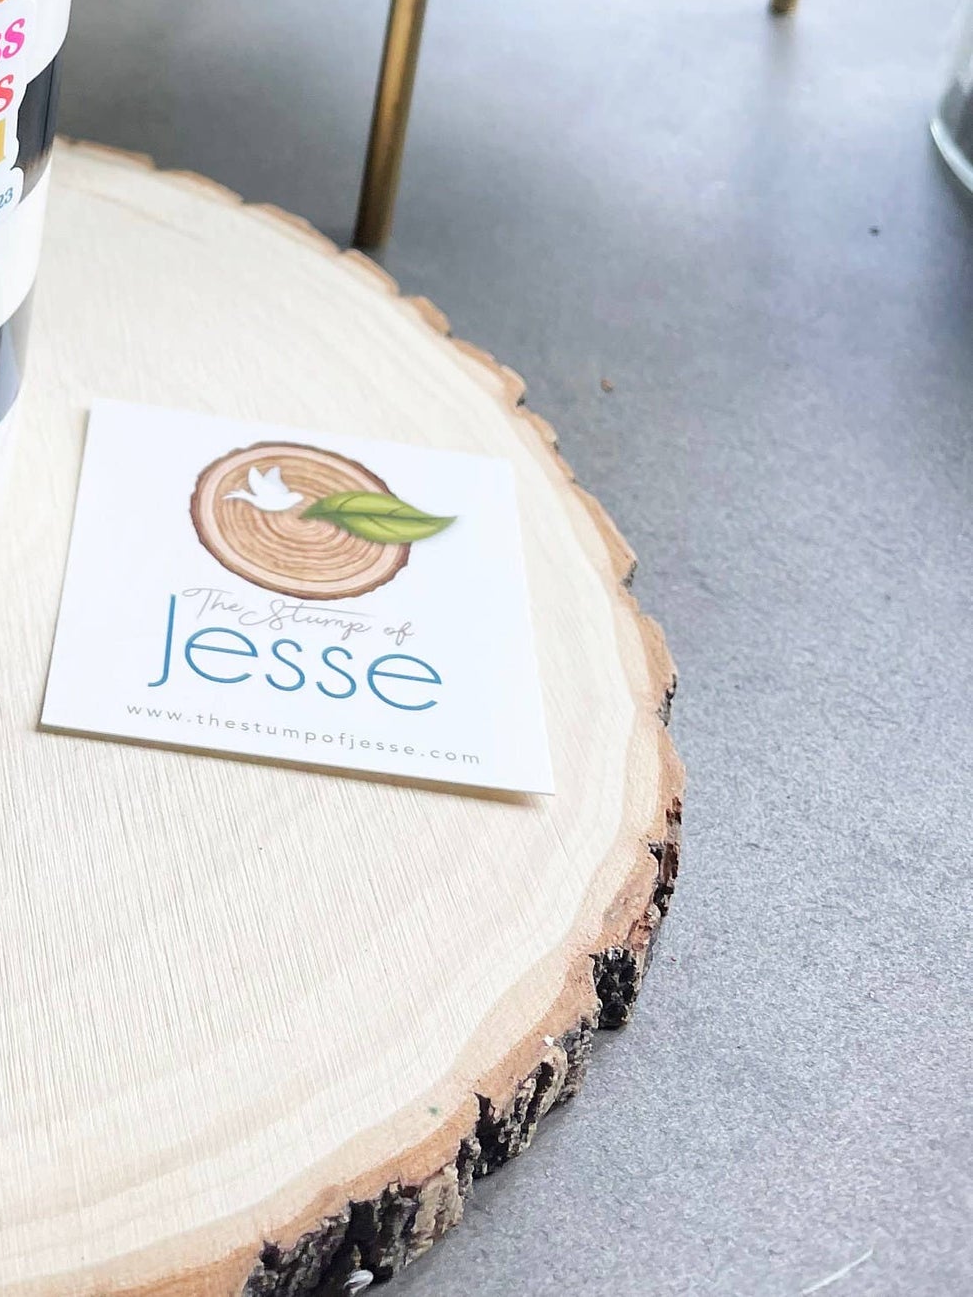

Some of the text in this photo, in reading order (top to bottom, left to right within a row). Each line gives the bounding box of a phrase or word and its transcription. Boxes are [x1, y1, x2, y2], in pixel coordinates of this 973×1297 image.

[181, 588, 416, 646] The Stump of
[147, 593, 443, 711] Jesse
[126, 703, 482, 766] www.thestumpofjesse.com
